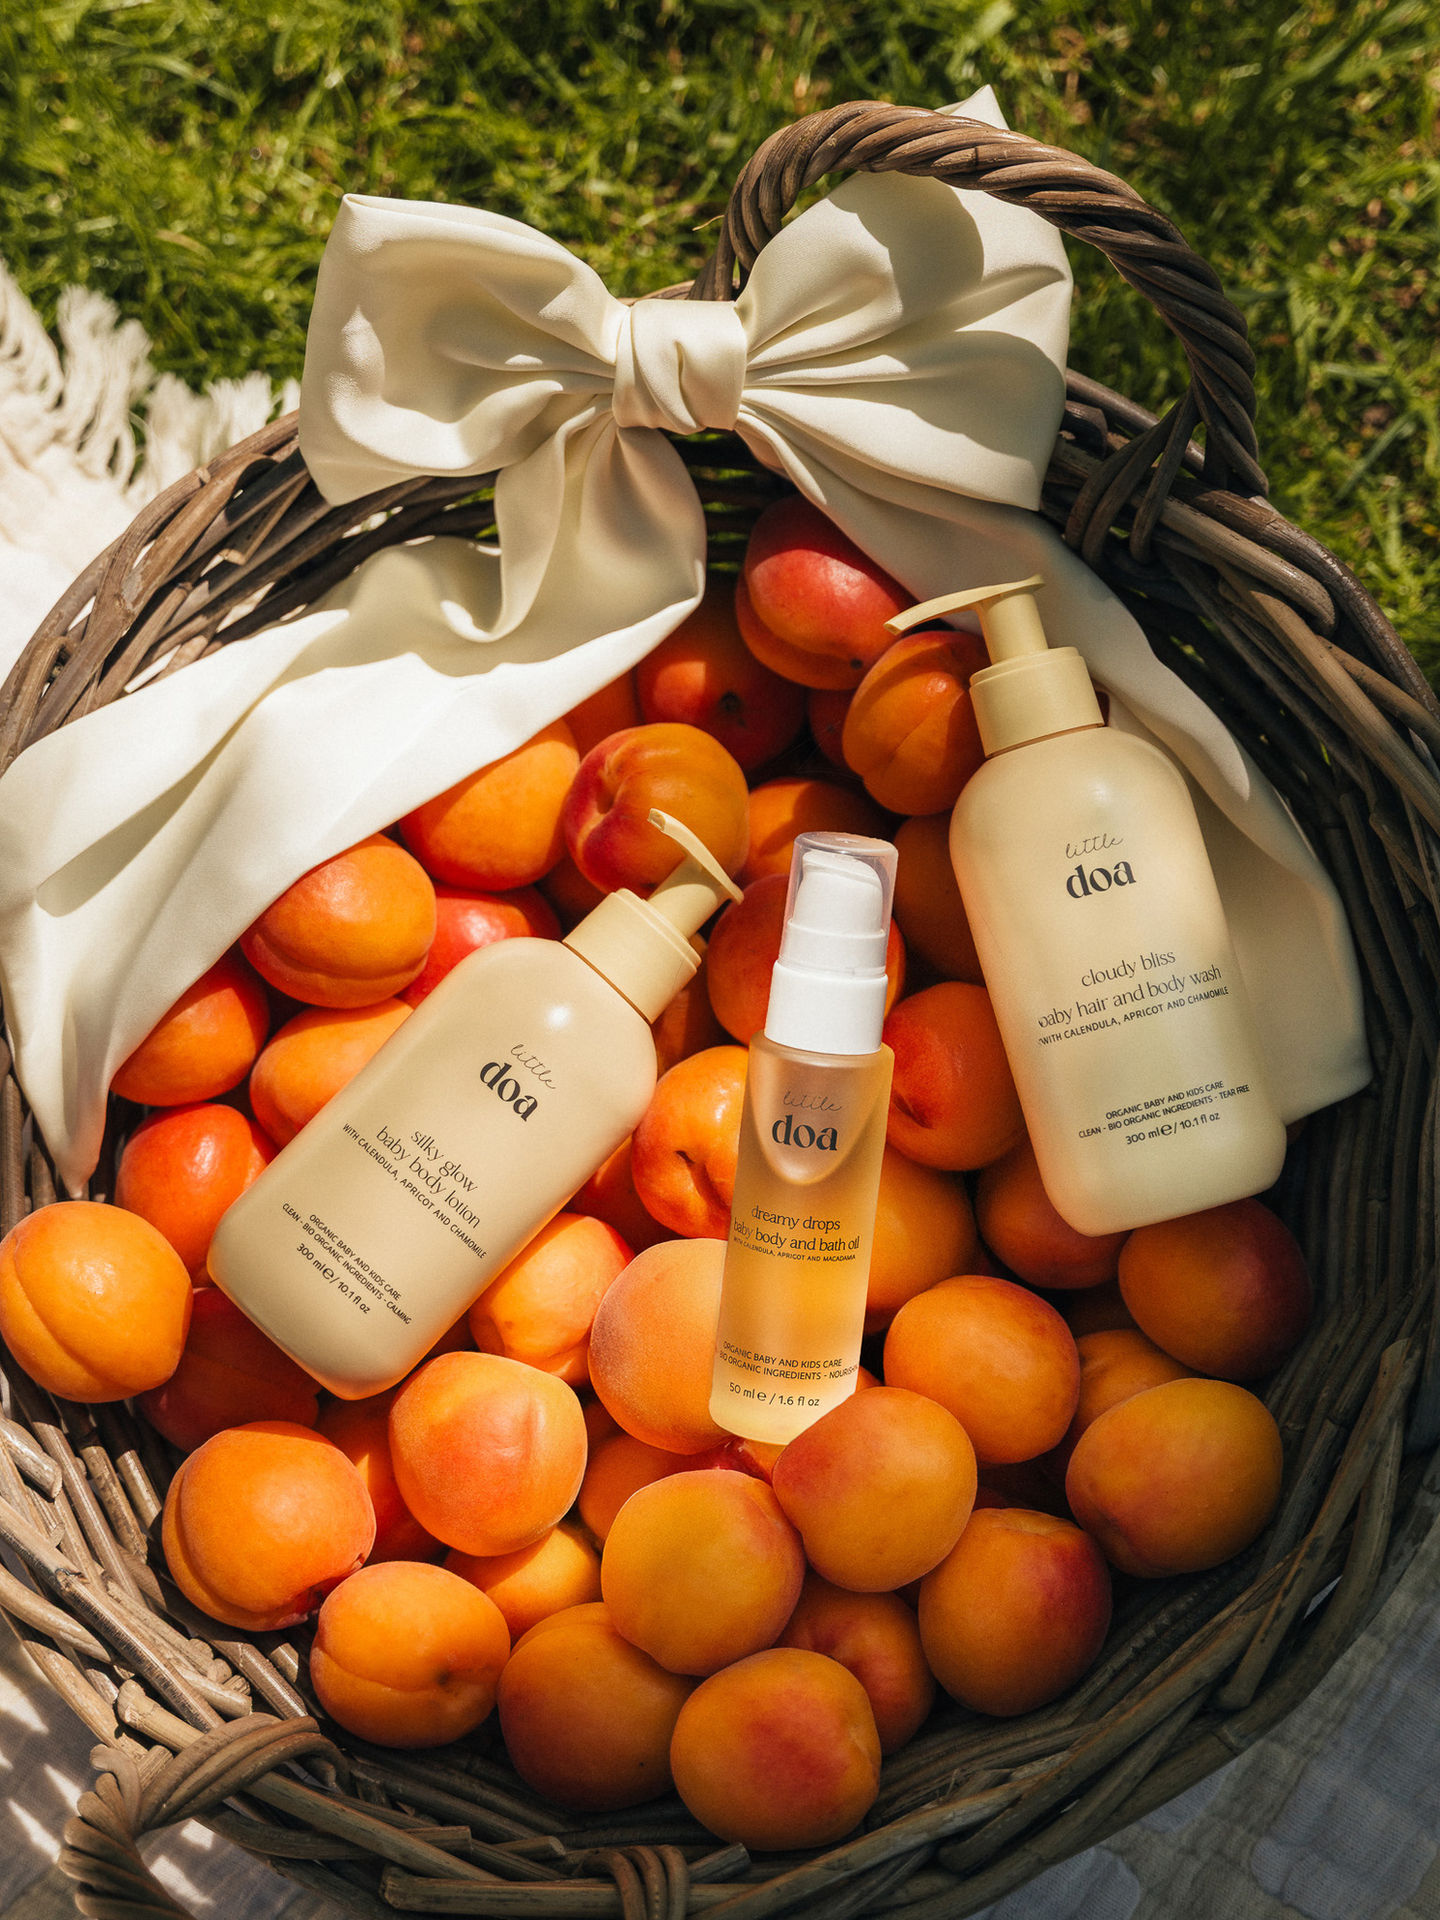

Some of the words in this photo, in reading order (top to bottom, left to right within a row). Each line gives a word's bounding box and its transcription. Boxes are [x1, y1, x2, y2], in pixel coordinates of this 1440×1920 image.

[1065, 833, 1124, 859] little
[1066, 861, 1137, 899] doa
[1081, 959, 1137, 987] cloudy
[1140, 951, 1176, 971] bliss
[1076, 998, 1108, 1017] hair
[1113, 983, 1145, 1007] and
[1146, 974, 1186, 997] body
[1189, 964, 1222, 985] wash
[1039, 1032, 1062, 1046] WITH
[1063, 1017, 1121, 1039] CALENDULA,
[1123, 1003, 1164, 1022] APRICOT
[1166, 998, 1186, 1010] AND
[1187, 986, 1229, 1004] CHAMOMILE
[510, 1044, 556, 1090] little
[479, 1061, 538, 1122] doa
[1078, 1126, 1102, 1139] CLEAN
[1108, 1121, 1122, 1131] BIO
[1123, 1110, 1161, 1127] ORGANIC
[1162, 1095, 1213, 1116] INGREDIENTS
[1219, 1089, 1236, 1100] TEAR
[1236, 1084, 1250, 1095] FREE
[1105, 1103, 1143, 1120] ORGANIC
[1144, 1097, 1166, 1110] BABY
[1167, 1091, 1185, 1103] AND
[1186, 1086, 1205, 1098] KIDS
[1205, 1080, 1225, 1092] CARE
[772, 1114, 838, 1151] doa
[1125, 1132, 1146, 1145] 300
[1180, 1118, 1200, 1130] 10.1
[1200, 1114, 1208, 1124] fl
[1209, 1112, 1220, 1122] oz
[376, 1125, 411, 1162] baby
[408, 1156, 447, 1195] body
[444, 1190, 481, 1229] lotion
[410, 1130, 444, 1162] silky
[438, 1160, 478, 1193] glow
[342, 1122, 360, 1141] WITH
[357, 1137, 398, 1181] CALENDULA,
[399, 1178, 435, 1210] APRICOT
[433, 1209, 451, 1226] AND
[450, 1224, 488, 1259] CHAMOMILE
[751, 1205, 800, 1229] dreamy
[802, 1216, 841, 1234] drops
[755, 1227, 787, 1249] body
[790, 1237, 816, 1250] and
[819, 1237, 846, 1252] bath
[848, 1236, 860, 1250] oil
[282, 1202, 301, 1222] CLEAN
[302, 1222, 315, 1236] BIO
[313, 1233, 344, 1263] ORGANIC
[342, 1260, 383, 1300] INGREDIENTS
[386, 1301, 412, 1325] CALMING
[309, 1214, 339, 1243] ORGANIC
[336, 1240, 356, 1259] BABY
[354, 1257, 370, 1272] AND
[368, 1269, 385, 1287] KIDS
[383, 1283, 402, 1301] CARE
[777, 1251, 805, 1260] APRICOT
[823, 1254, 856, 1262] MACADAMIA
[296, 1242, 314, 1261] 300
[337, 1281, 355, 1299] 10.1
[352, 1295, 362, 1305] fl
[359, 1303, 371, 1314] oz
[727, 1356, 761, 1374] ORGANIC
[763, 1367, 821, 1380] INGREDIENTS
[753, 1353, 777, 1365] BABY
[778, 1358, 799, 1368] AND
[800, 1360, 821, 1369] KIDS
[822, 1358, 843, 1368] CARE
[729, 1382, 741, 1394] 50
[778, 1395, 794, 1406] 1.6
[797, 1396, 805, 1406] fl
[808, 1398, 820, 1406] oz
